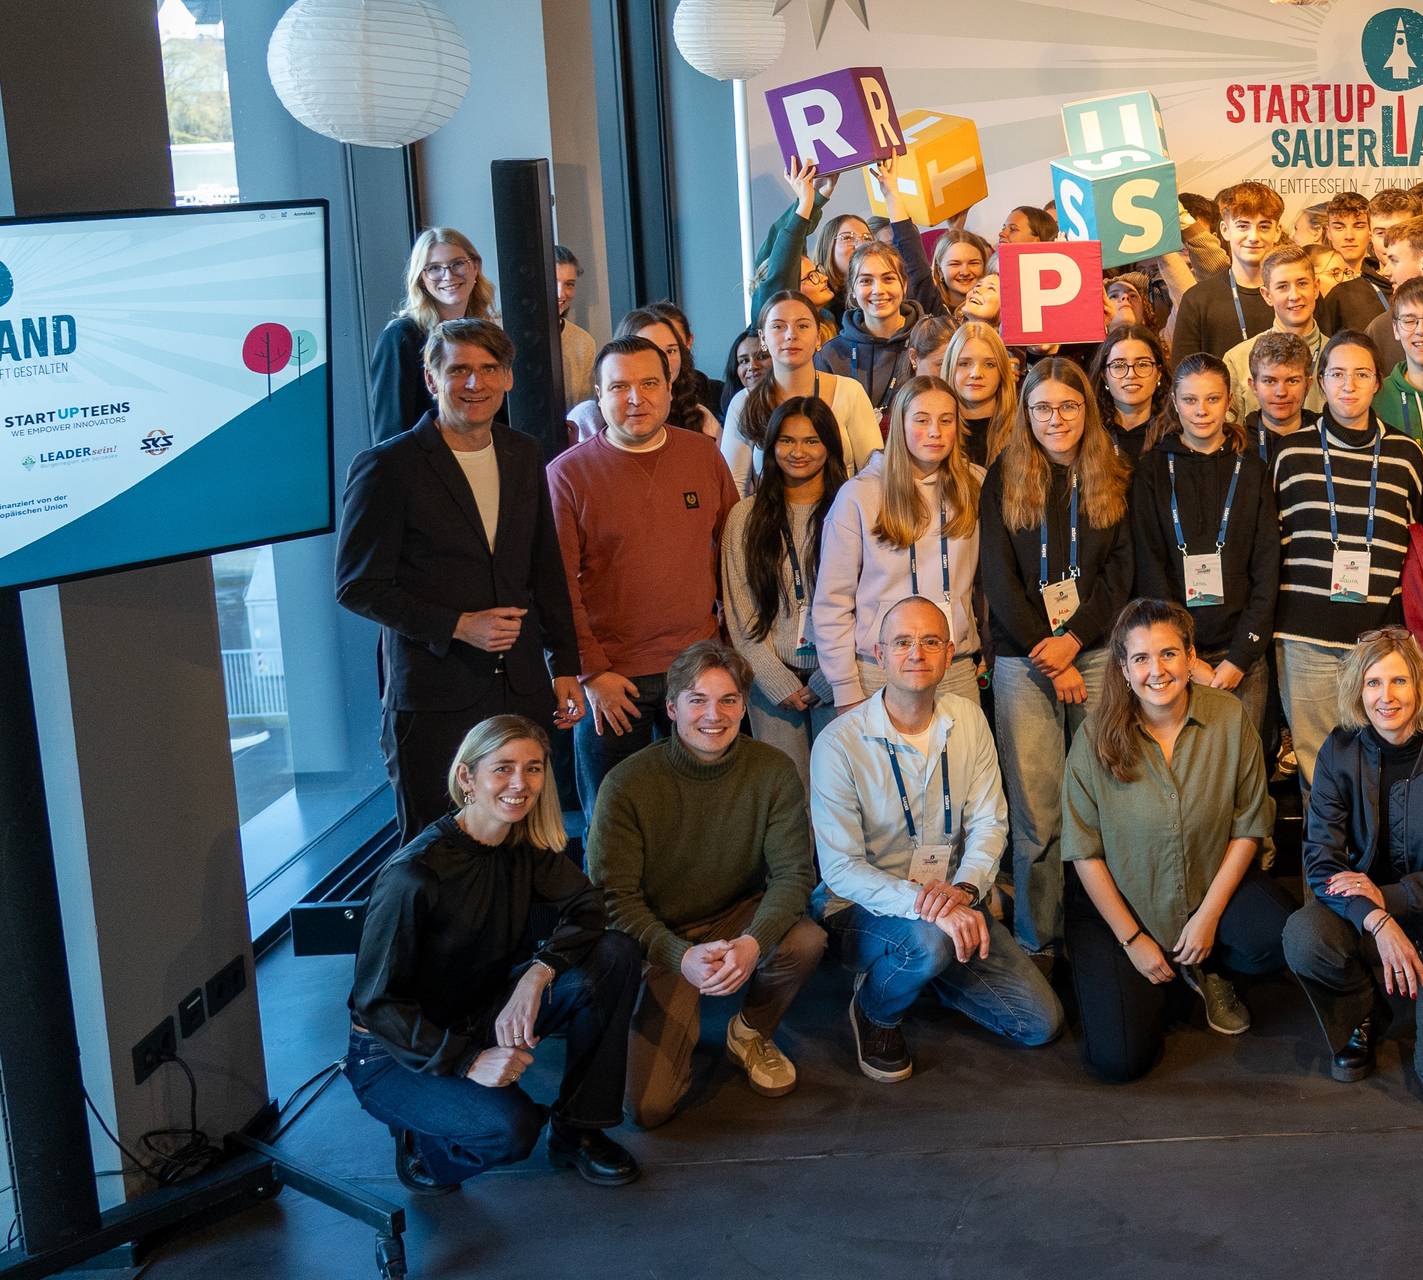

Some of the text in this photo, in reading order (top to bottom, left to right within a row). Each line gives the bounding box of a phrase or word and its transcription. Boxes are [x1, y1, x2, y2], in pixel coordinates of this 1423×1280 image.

[860, 76, 901, 148] R
[1225, 83, 1376, 123] STARTUP
[782, 88, 858, 167] R
[1280, 178, 1358, 194] ENTFESSELN
[1060, 178, 1090, 241] S
[1112, 178, 1163, 254] S
[1018, 252, 1082, 333] P
[13, 361, 69, 379] GESTALTEN
[11, 415, 127, 437] WE EMPOWER INNOVATORS
[40, 447, 91, 463] LEADER
[140, 434, 174, 450] SKS
[45, 503, 69, 512] Union
